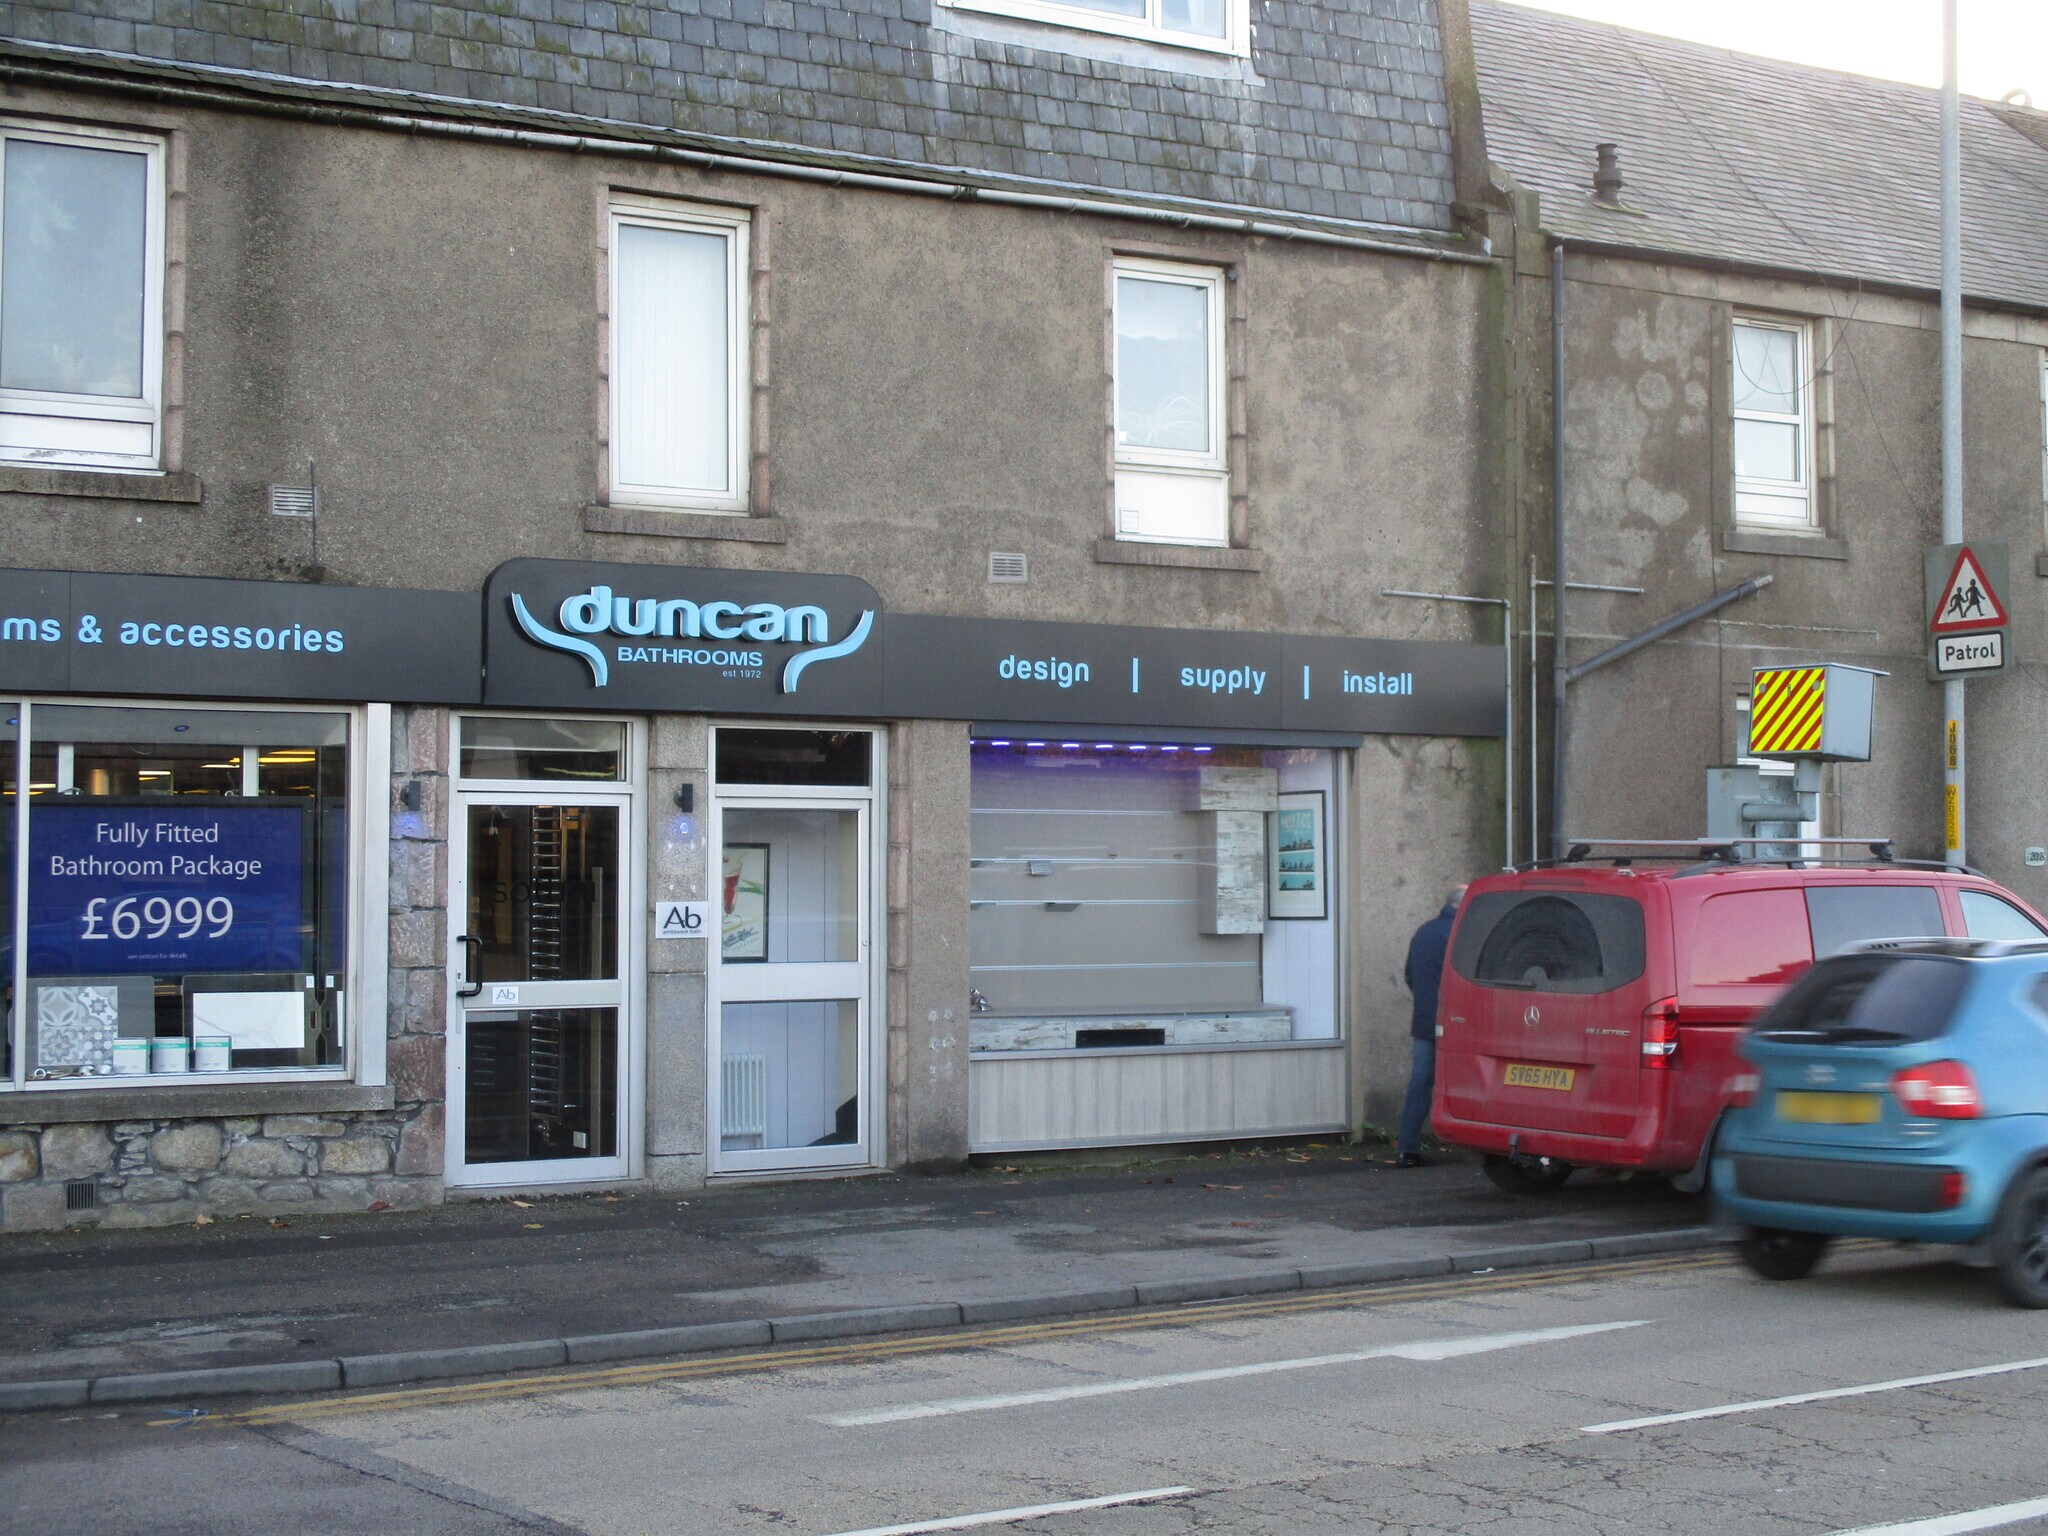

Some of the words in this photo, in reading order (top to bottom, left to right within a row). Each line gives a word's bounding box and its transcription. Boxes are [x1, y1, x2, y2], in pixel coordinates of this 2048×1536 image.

[560, 585, 828, 643] duncan
[78, 614, 103, 644] &
[120, 621, 344, 653] accessories
[617, 646, 764, 667] BATHROOMS
[1945, 642, 1995, 662] Patrol
[722, 669, 737, 679] est
[740, 669, 762, 679] 1972
[999, 654, 1090, 688] design
[1180, 665, 1267, 695] supply
[1342, 670, 1413, 696] install
[96, 822, 150, 848] Fully
[155, 822, 219, 843] Fitted
[51, 855, 164, 876] Bathroom
[171, 855, 262, 880] Package
[81, 896, 234, 940] £6999
[663, 906, 702, 929] Ab
[496, 988, 516, 1001] Ab
[1543, 1069, 1567, 1088] HYA
